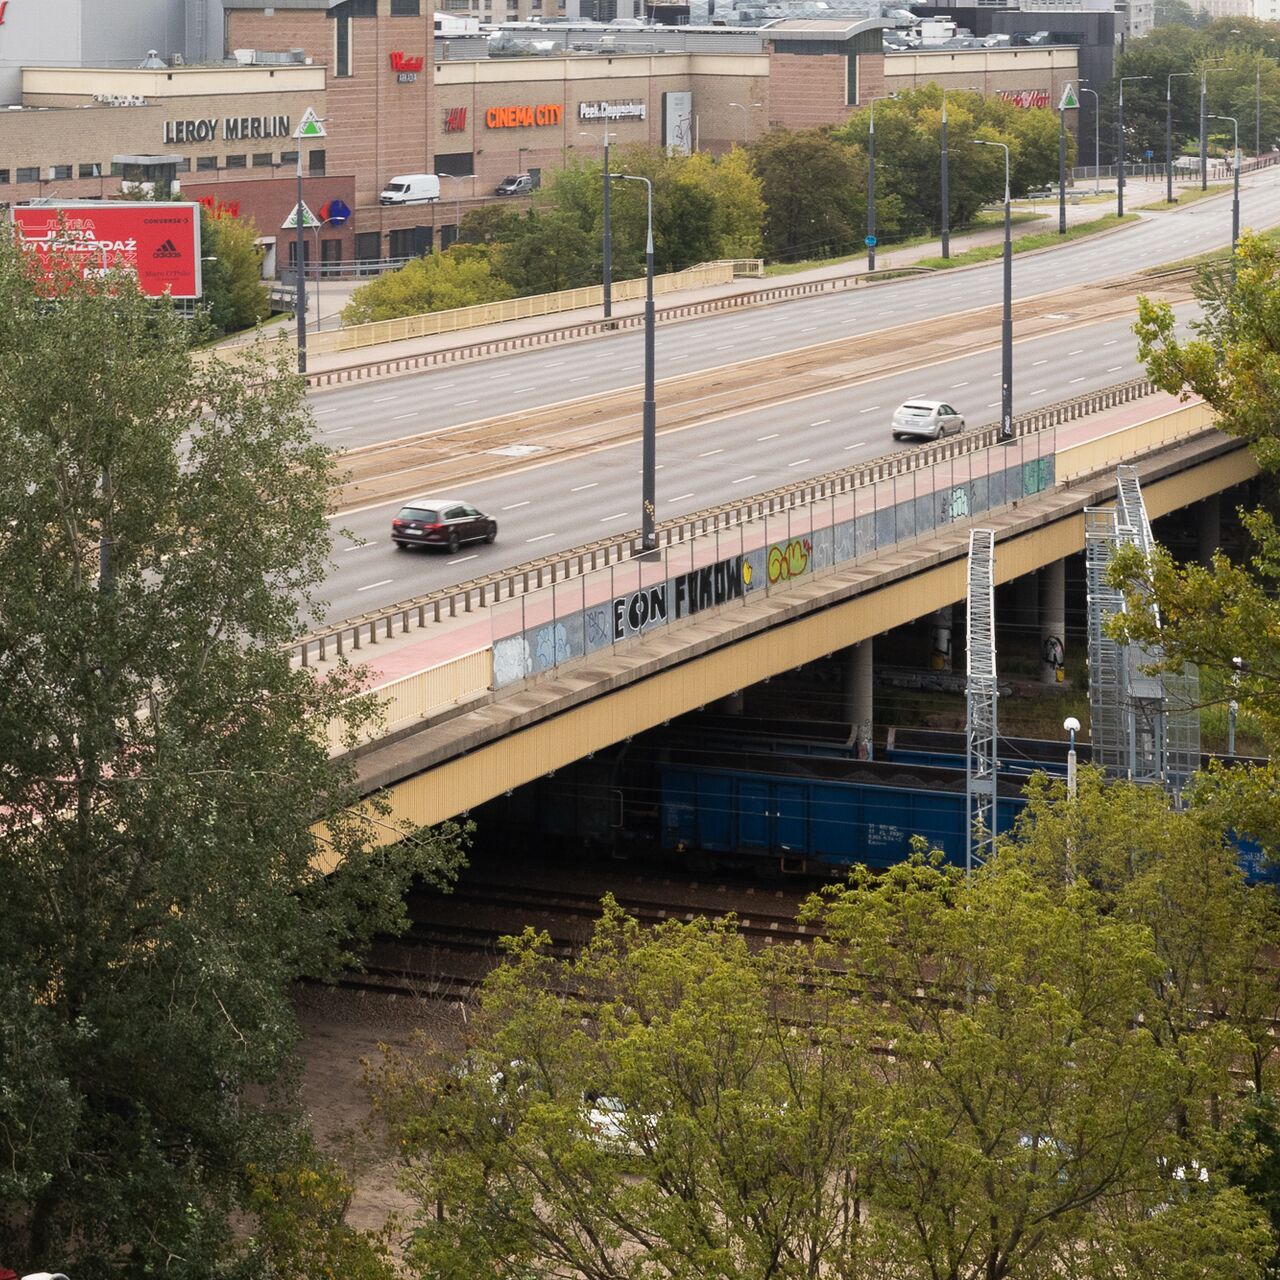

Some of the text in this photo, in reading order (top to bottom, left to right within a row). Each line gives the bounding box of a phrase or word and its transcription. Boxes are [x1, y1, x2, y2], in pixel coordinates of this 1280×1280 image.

[486, 104, 563, 128] CINEMA CITY
[163, 120, 218, 144] LEROY
[223, 116, 290, 140] MERLIN
